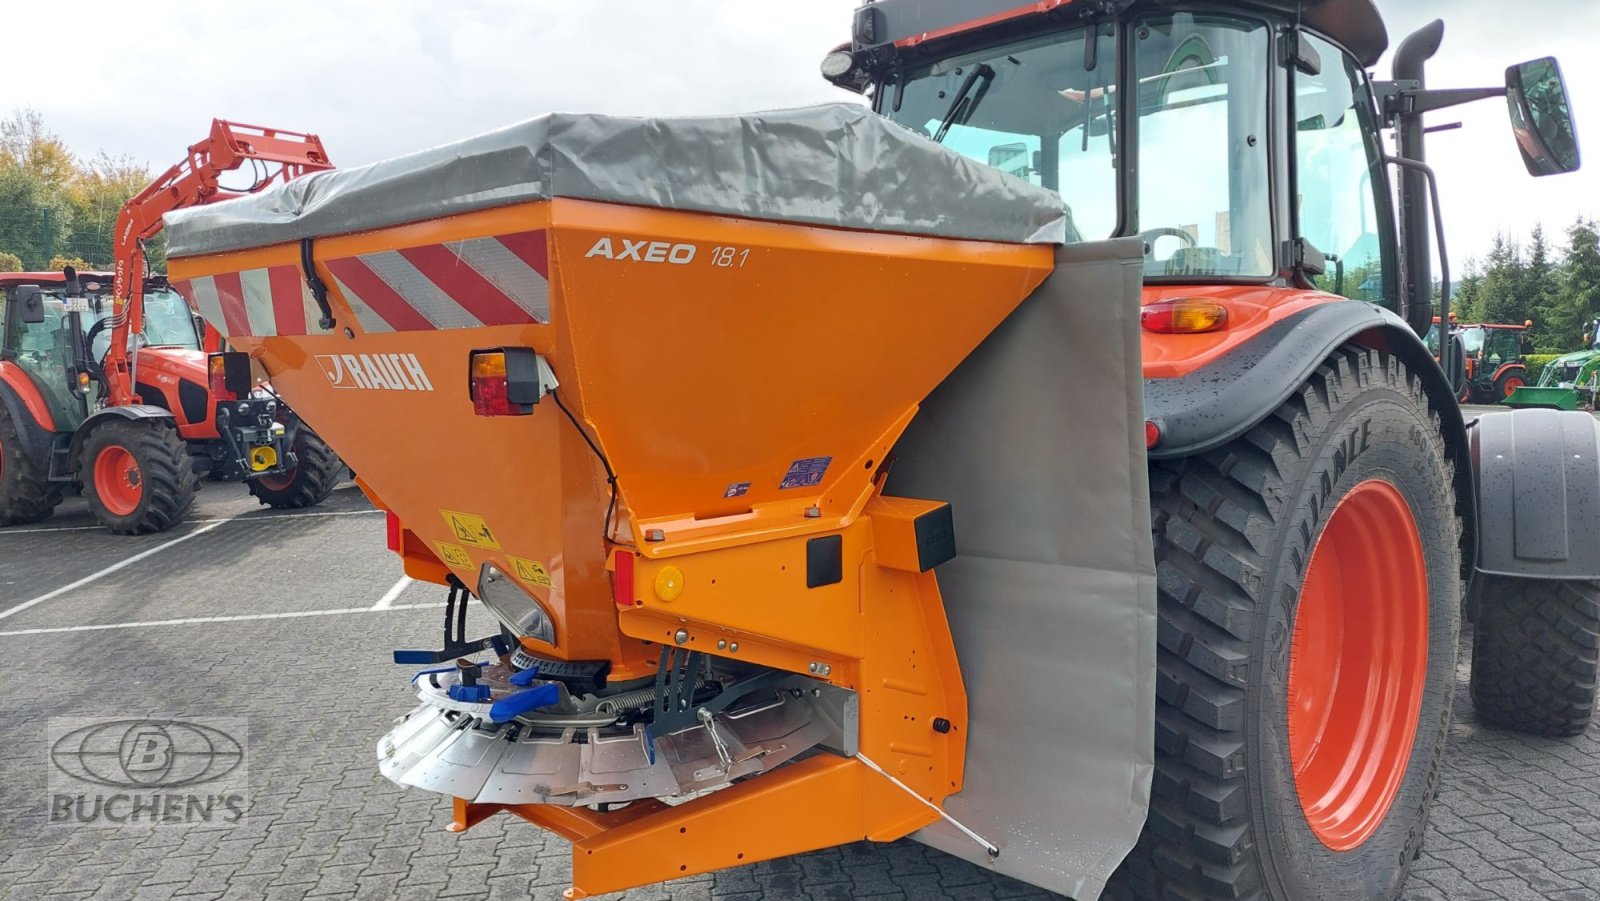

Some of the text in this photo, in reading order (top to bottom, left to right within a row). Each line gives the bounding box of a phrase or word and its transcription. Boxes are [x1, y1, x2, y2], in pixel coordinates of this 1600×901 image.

[584, 237, 750, 268] AXEO 18.1
[116, 260, 124, 298] Kubota
[341, 353, 434, 391] RAUCH
[1281, 418, 1372, 633] ALLIANCE
